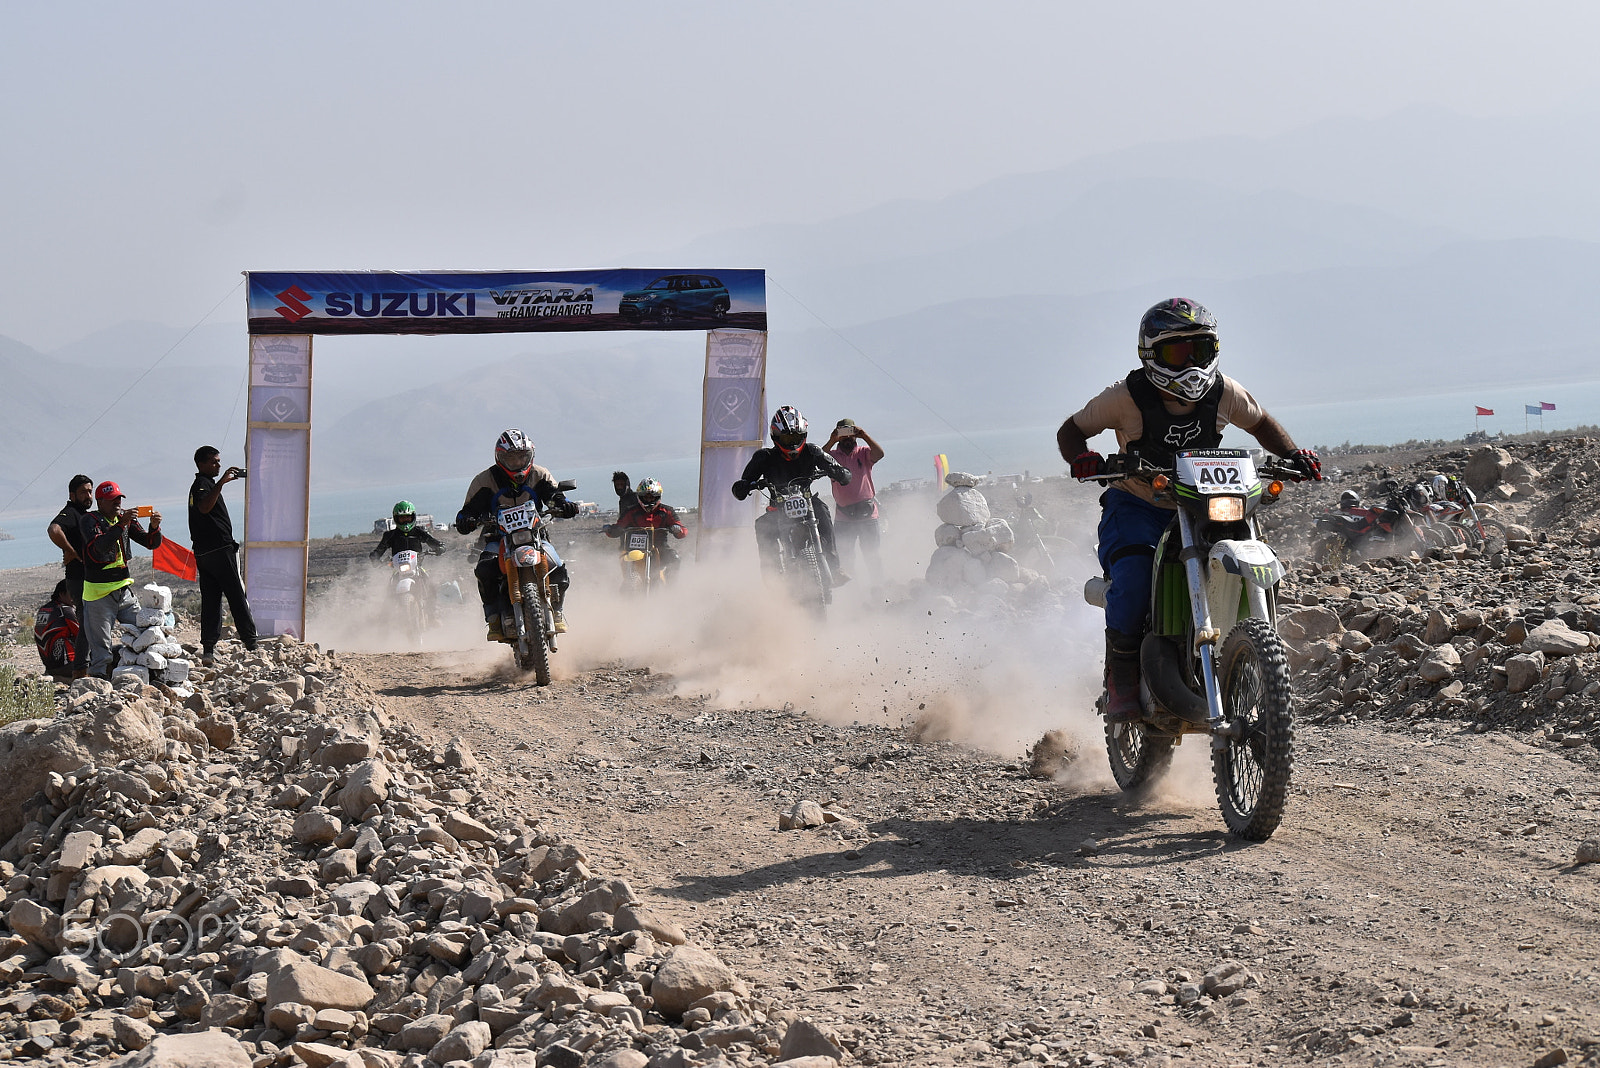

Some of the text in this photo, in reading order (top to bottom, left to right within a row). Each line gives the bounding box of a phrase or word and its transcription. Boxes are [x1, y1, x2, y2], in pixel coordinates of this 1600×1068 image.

[325, 292, 476, 317] SUZUKI
[489, 288, 594, 305] VITARA
[1200, 467, 1241, 485] A02
[785, 499, 806, 511] B08
[504, 510, 525, 524] B07
